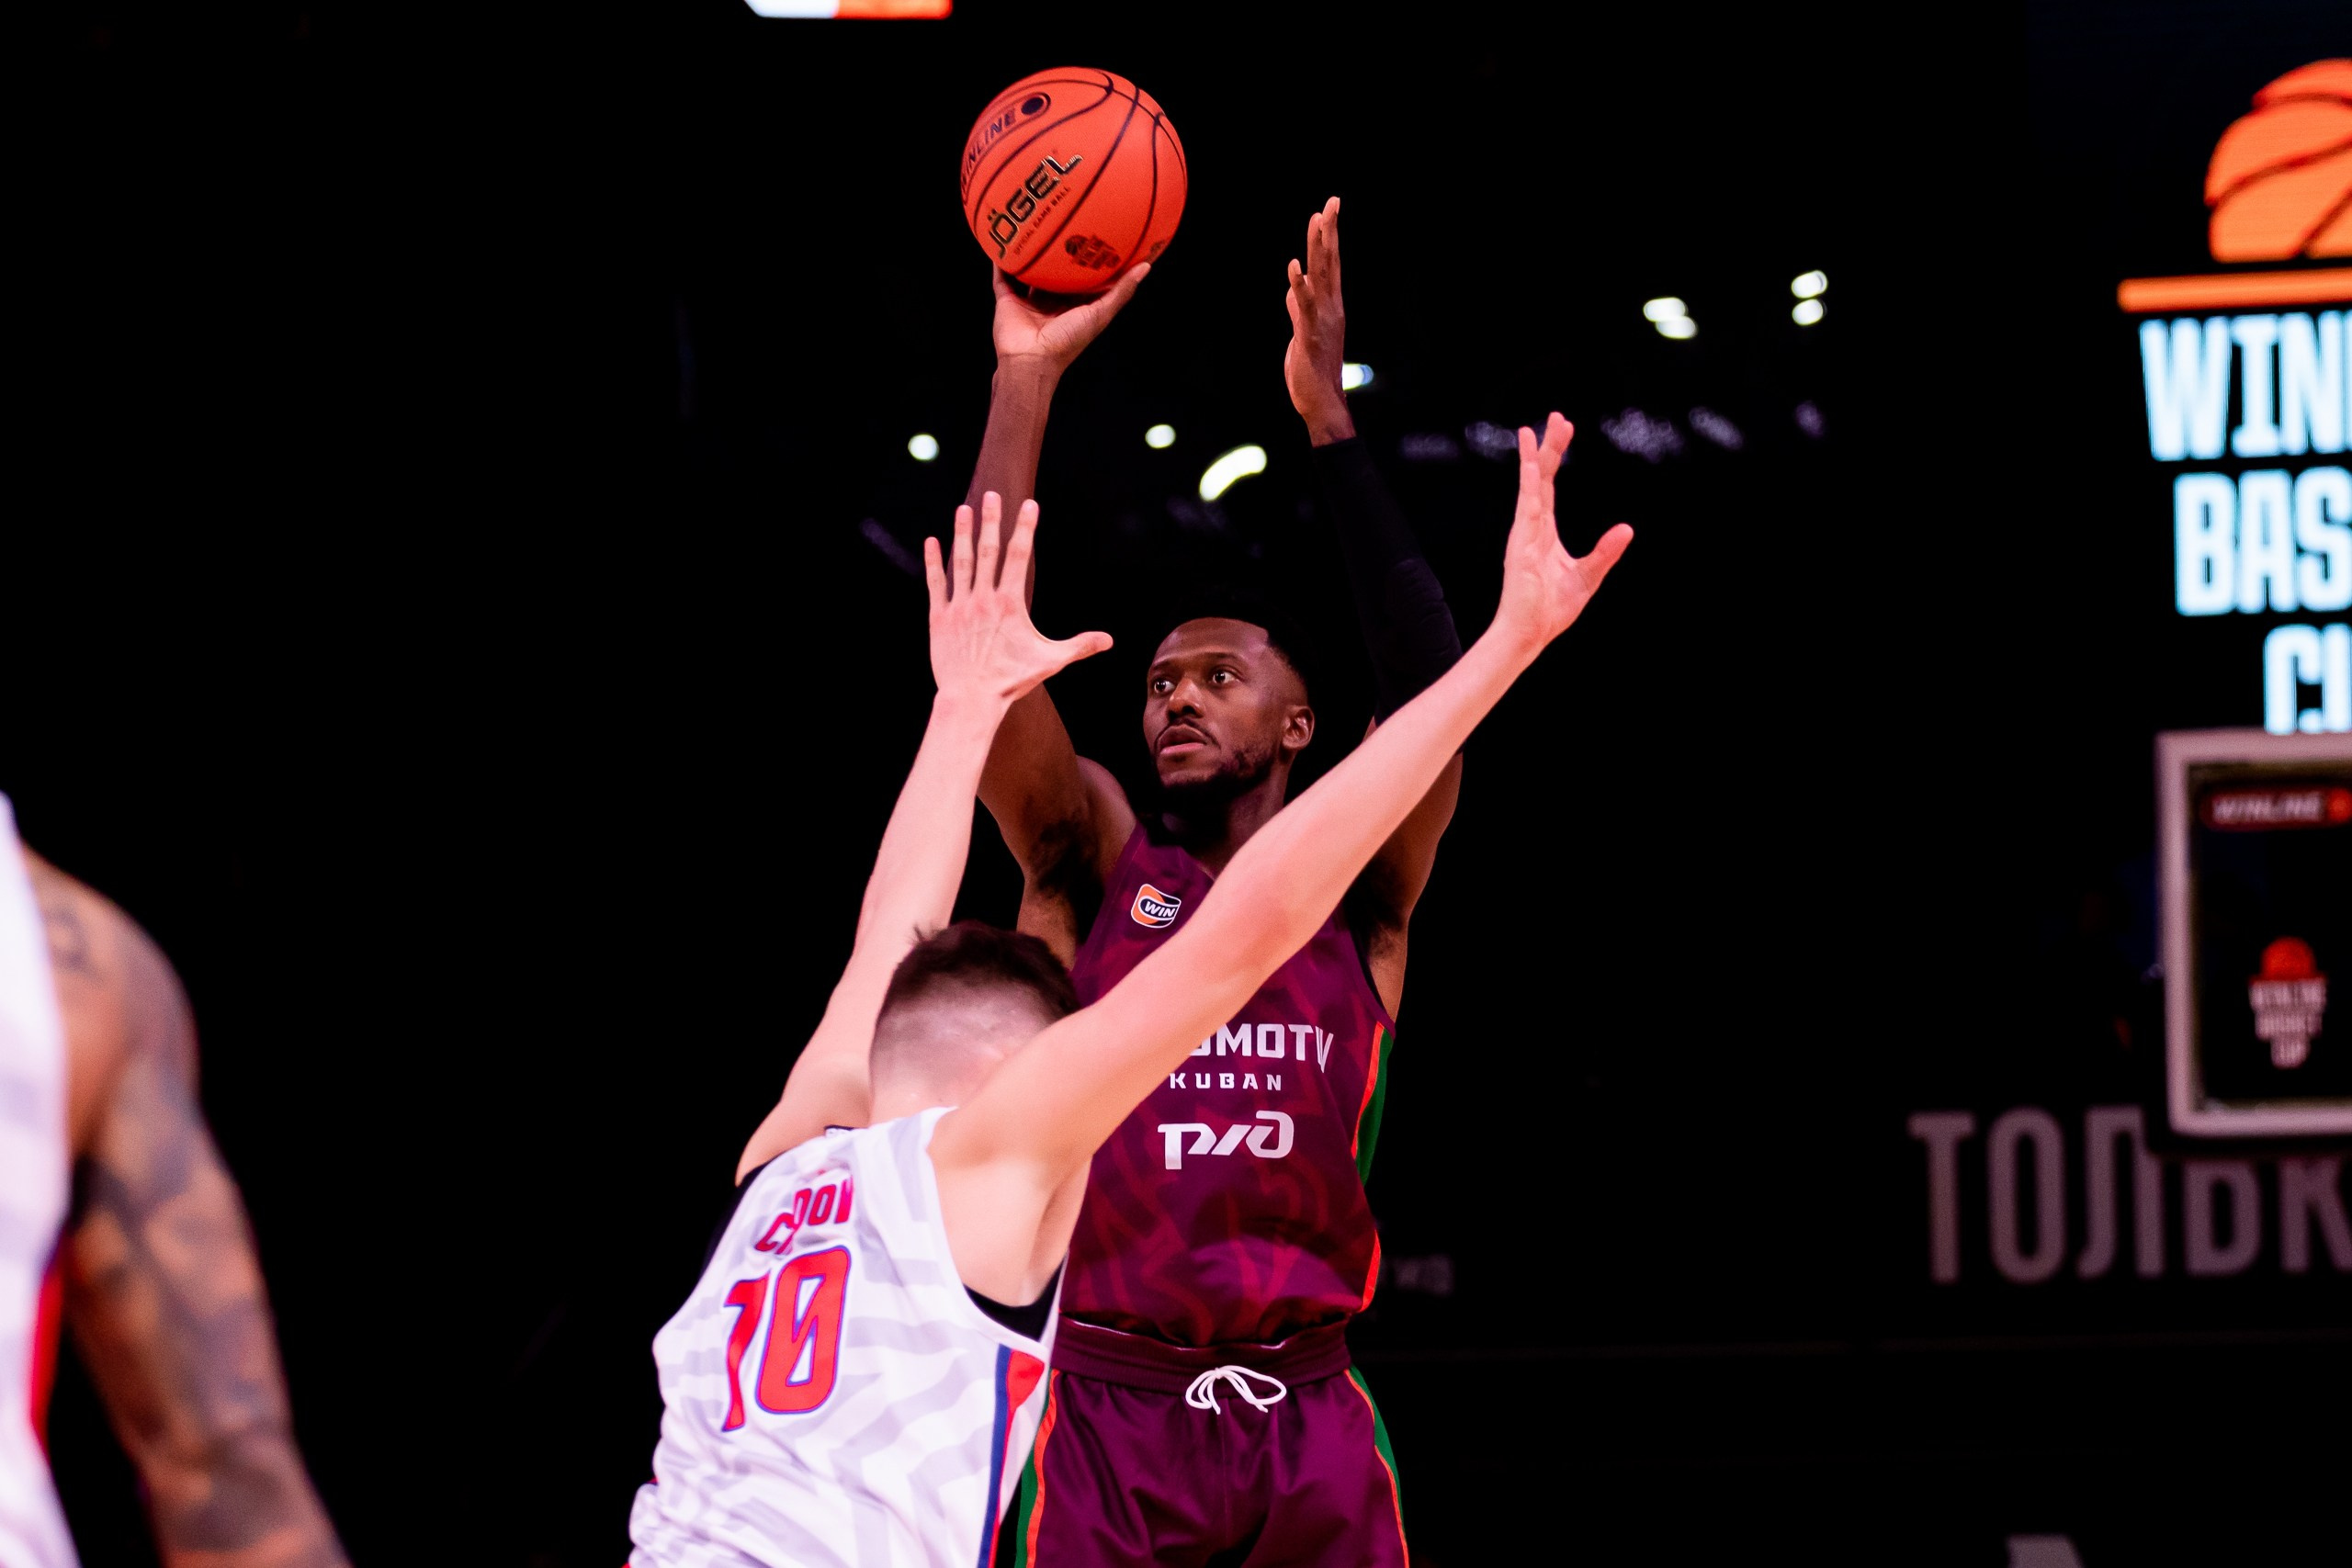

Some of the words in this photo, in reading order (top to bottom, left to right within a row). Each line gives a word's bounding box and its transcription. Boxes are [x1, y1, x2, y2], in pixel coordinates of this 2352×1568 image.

[989, 154, 1083, 259] JÖGEL
[2139, 310, 2352, 460] WIN
[1144, 900, 1176, 918] WIN
[1170, 1072, 1282, 1091] KUBAN
[721, 1245, 852, 1432] 10
